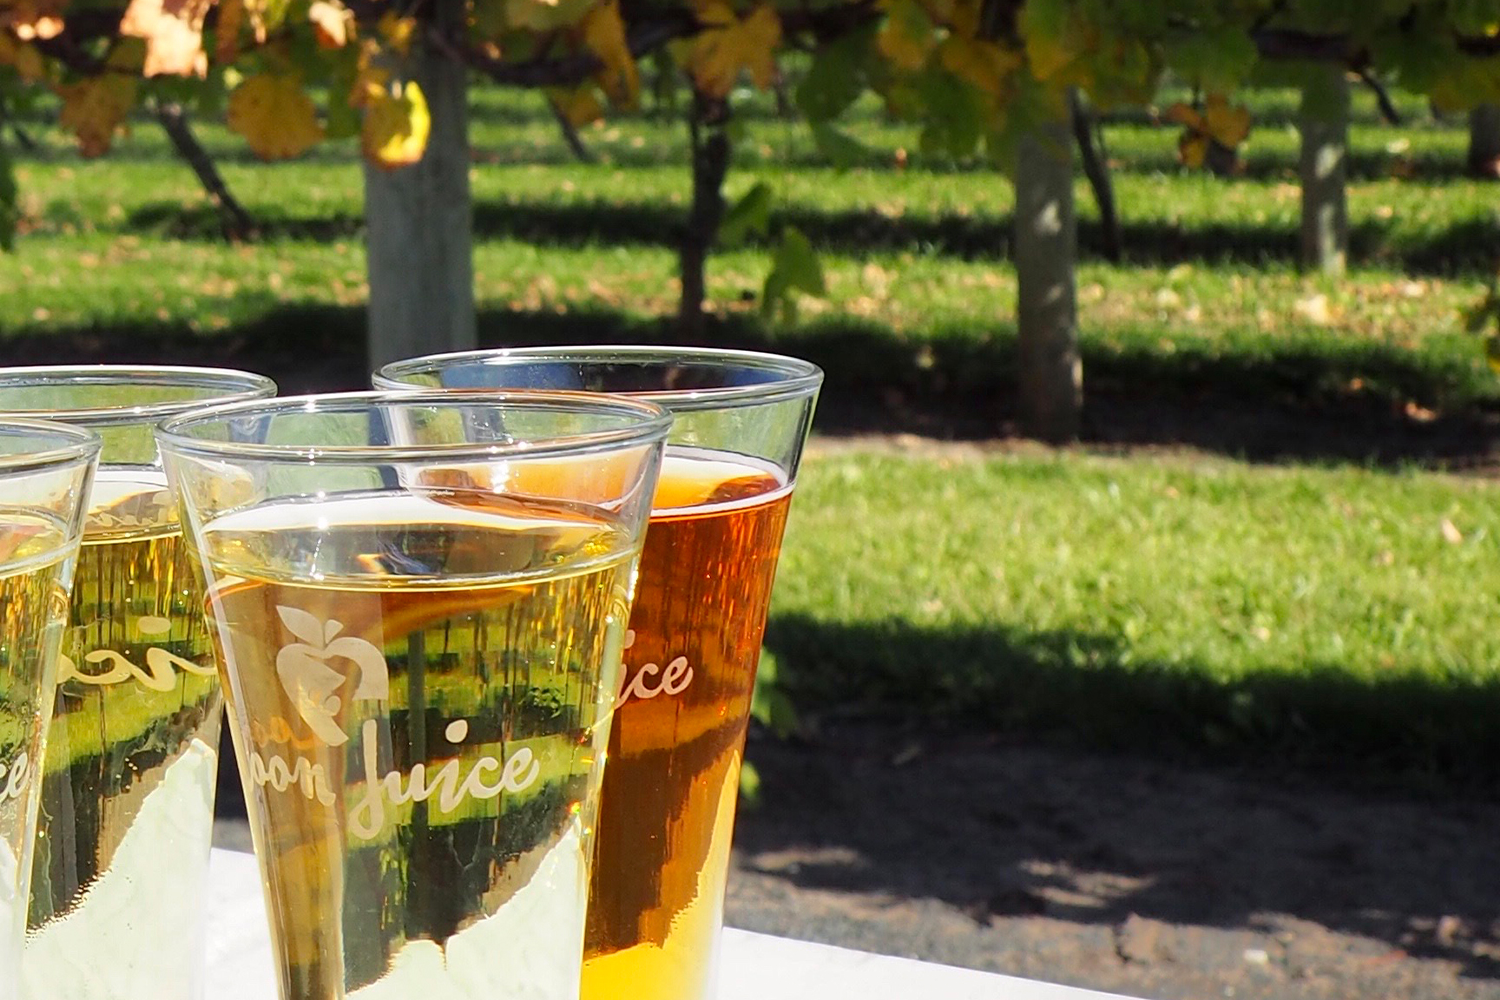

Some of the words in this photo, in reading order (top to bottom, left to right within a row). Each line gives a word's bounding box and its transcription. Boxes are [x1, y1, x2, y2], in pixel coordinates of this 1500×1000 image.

[614, 629, 693, 709] ice
[250, 752, 337, 807] oon
[349, 719, 539, 840] Juice
